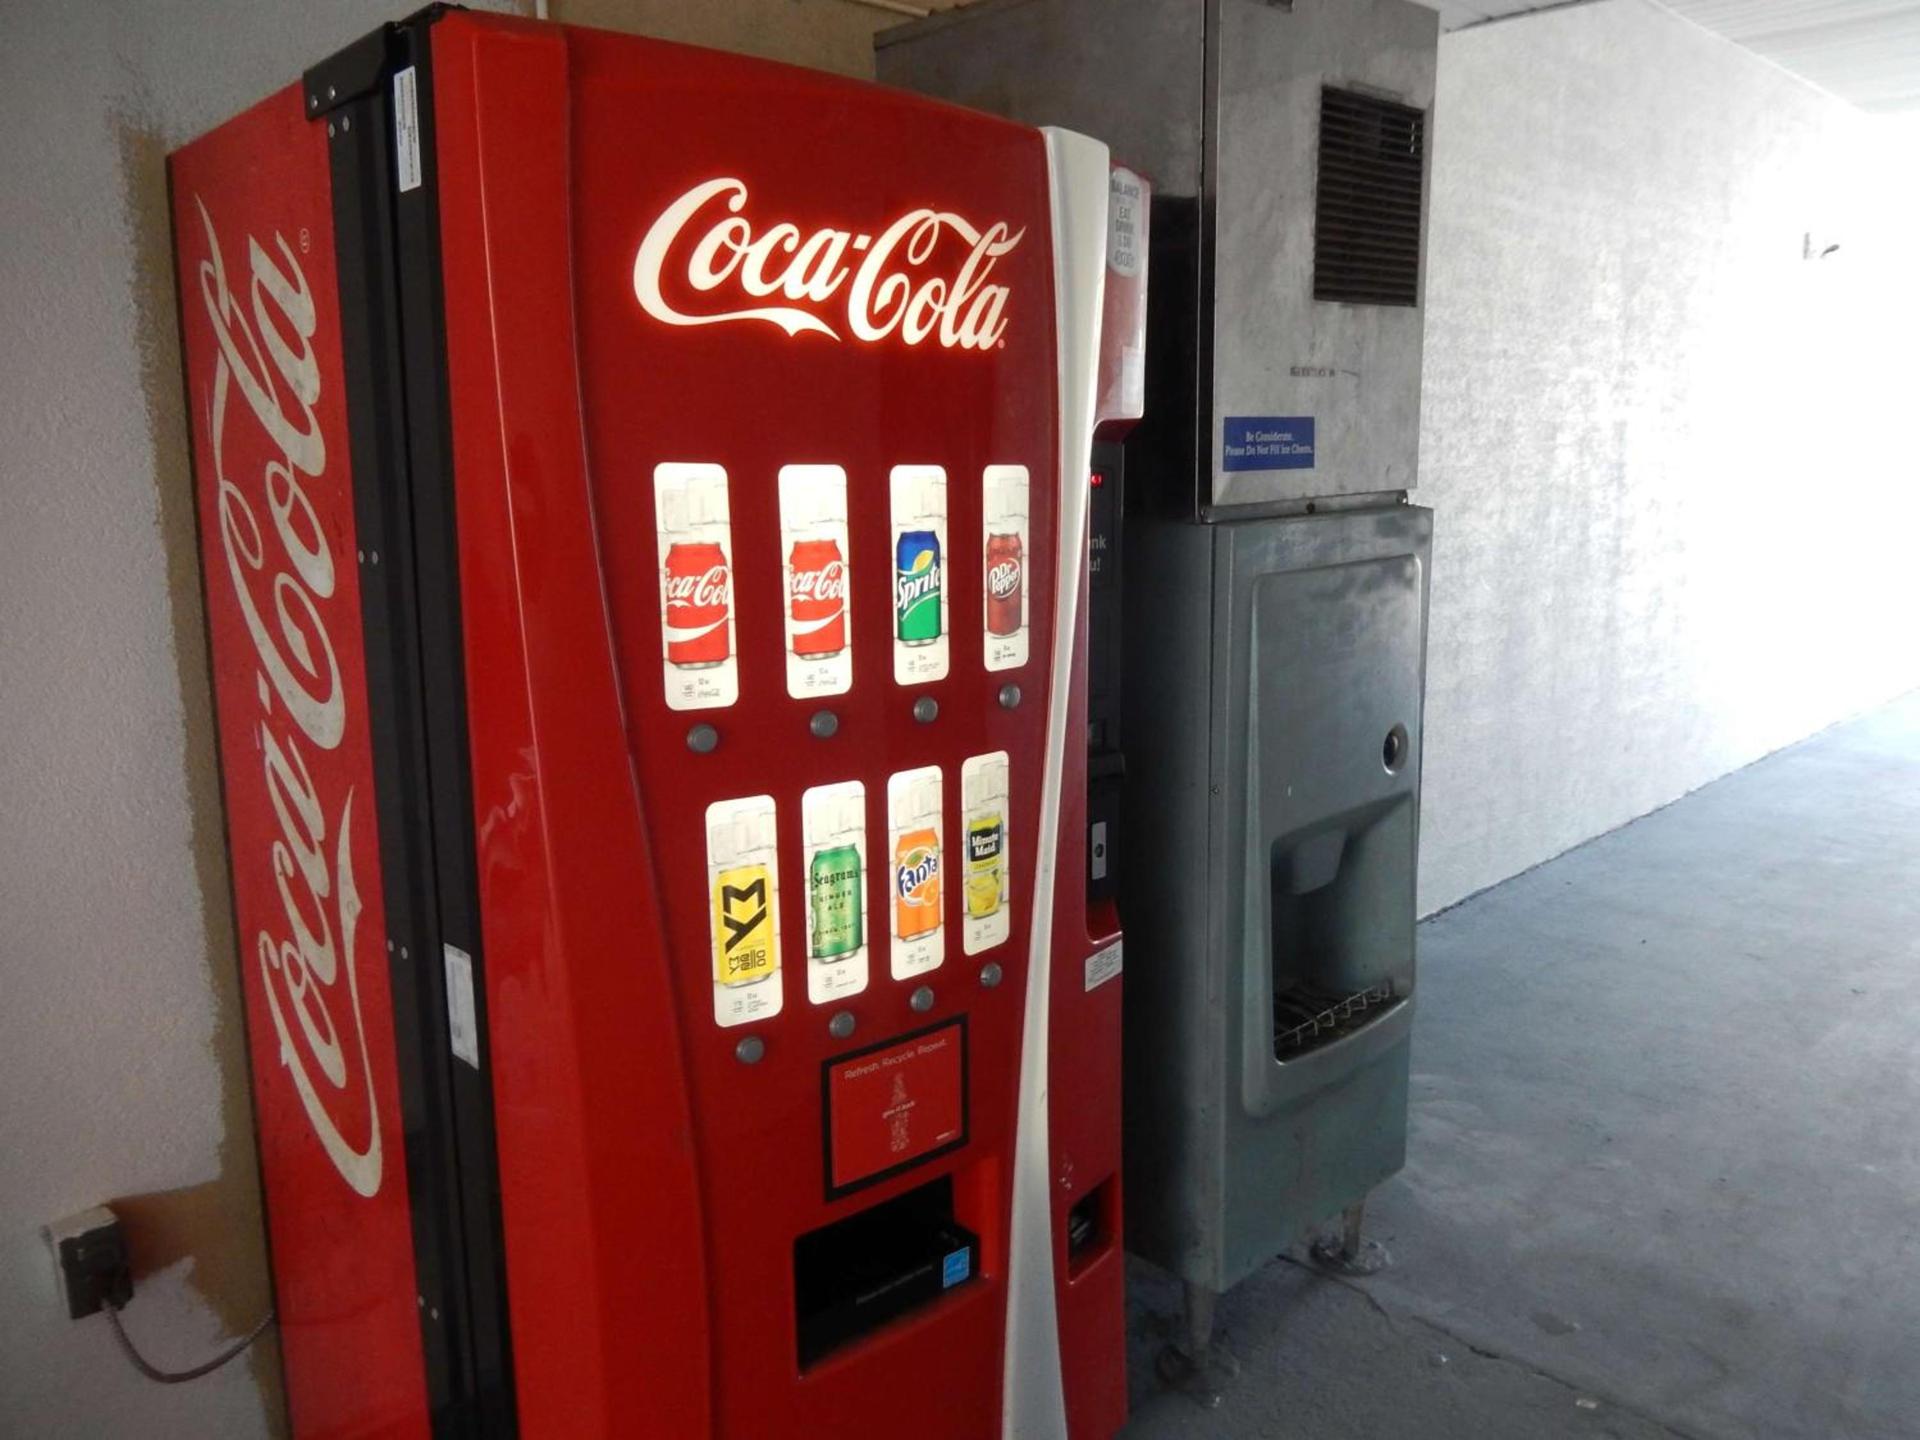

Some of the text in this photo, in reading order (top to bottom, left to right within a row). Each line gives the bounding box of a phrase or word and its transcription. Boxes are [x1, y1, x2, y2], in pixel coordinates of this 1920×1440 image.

[633, 177, 1027, 351] Coca-Cola
[897, 562, 941, 611] Sprite
[991, 567, 1020, 594] Pepper
[195, 193, 383, 1198] Coca-Cola
[971, 832, 999, 847] Minute
[975, 841, 996, 857] Maid
[844, 1062, 880, 1080] Refresh
[881, 1049, 915, 1066] Recycle
